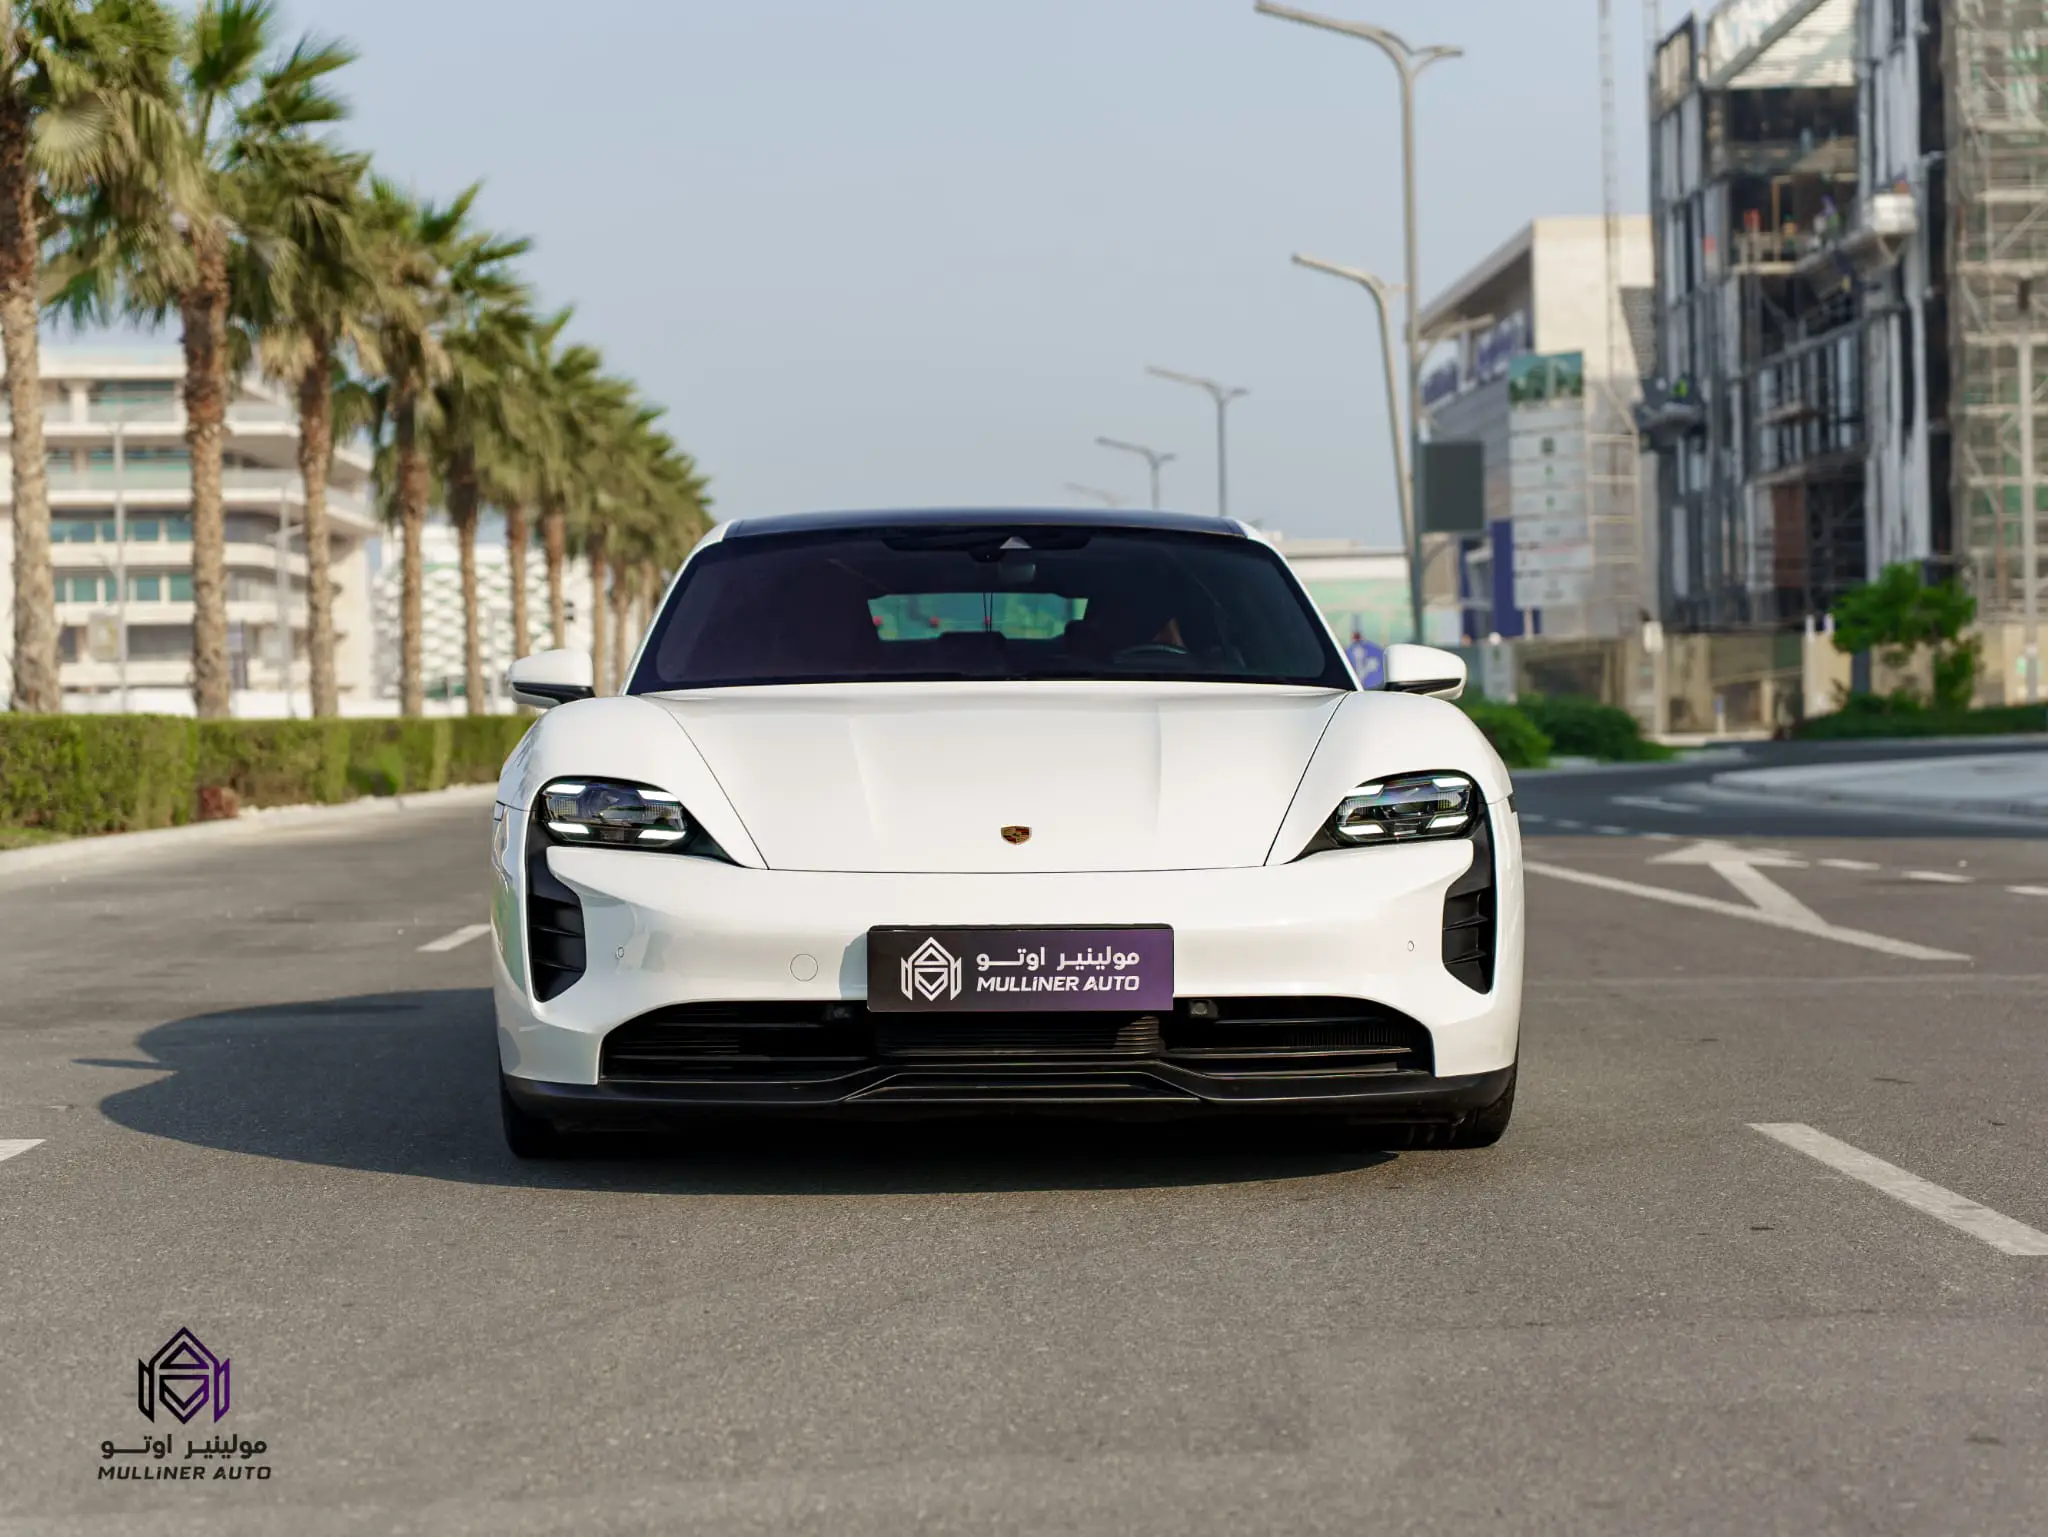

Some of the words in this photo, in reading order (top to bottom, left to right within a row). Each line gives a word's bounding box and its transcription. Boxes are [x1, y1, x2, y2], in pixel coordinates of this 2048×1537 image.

[976, 947, 1045, 971] اوتو
[1057, 946, 1140, 970] مولينير
[1083, 976, 1140, 991] AUTO
